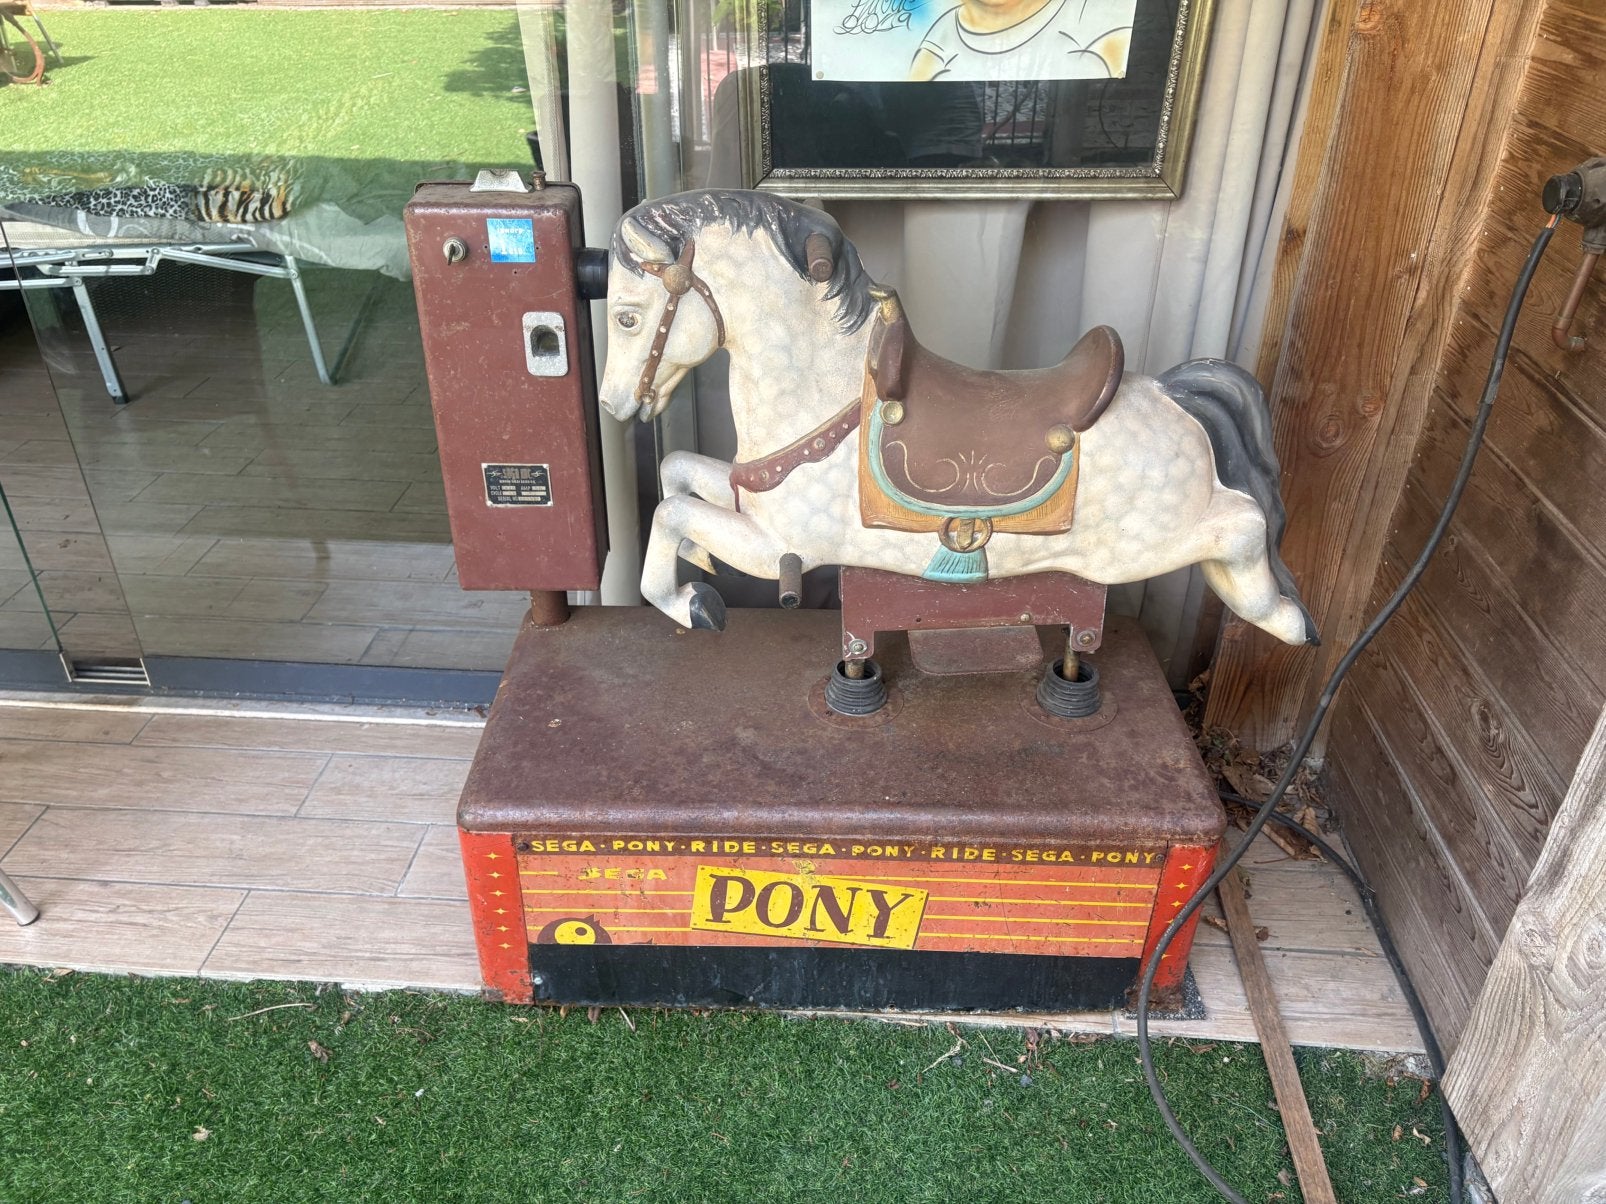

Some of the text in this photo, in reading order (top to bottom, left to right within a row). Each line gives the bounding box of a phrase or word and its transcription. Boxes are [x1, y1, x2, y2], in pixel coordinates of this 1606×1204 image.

[531, 840, 1156, 864] SEGA PONY RIDE SEGA PONY RIDE SEGA PONY
[705, 873, 915, 939] PONY
